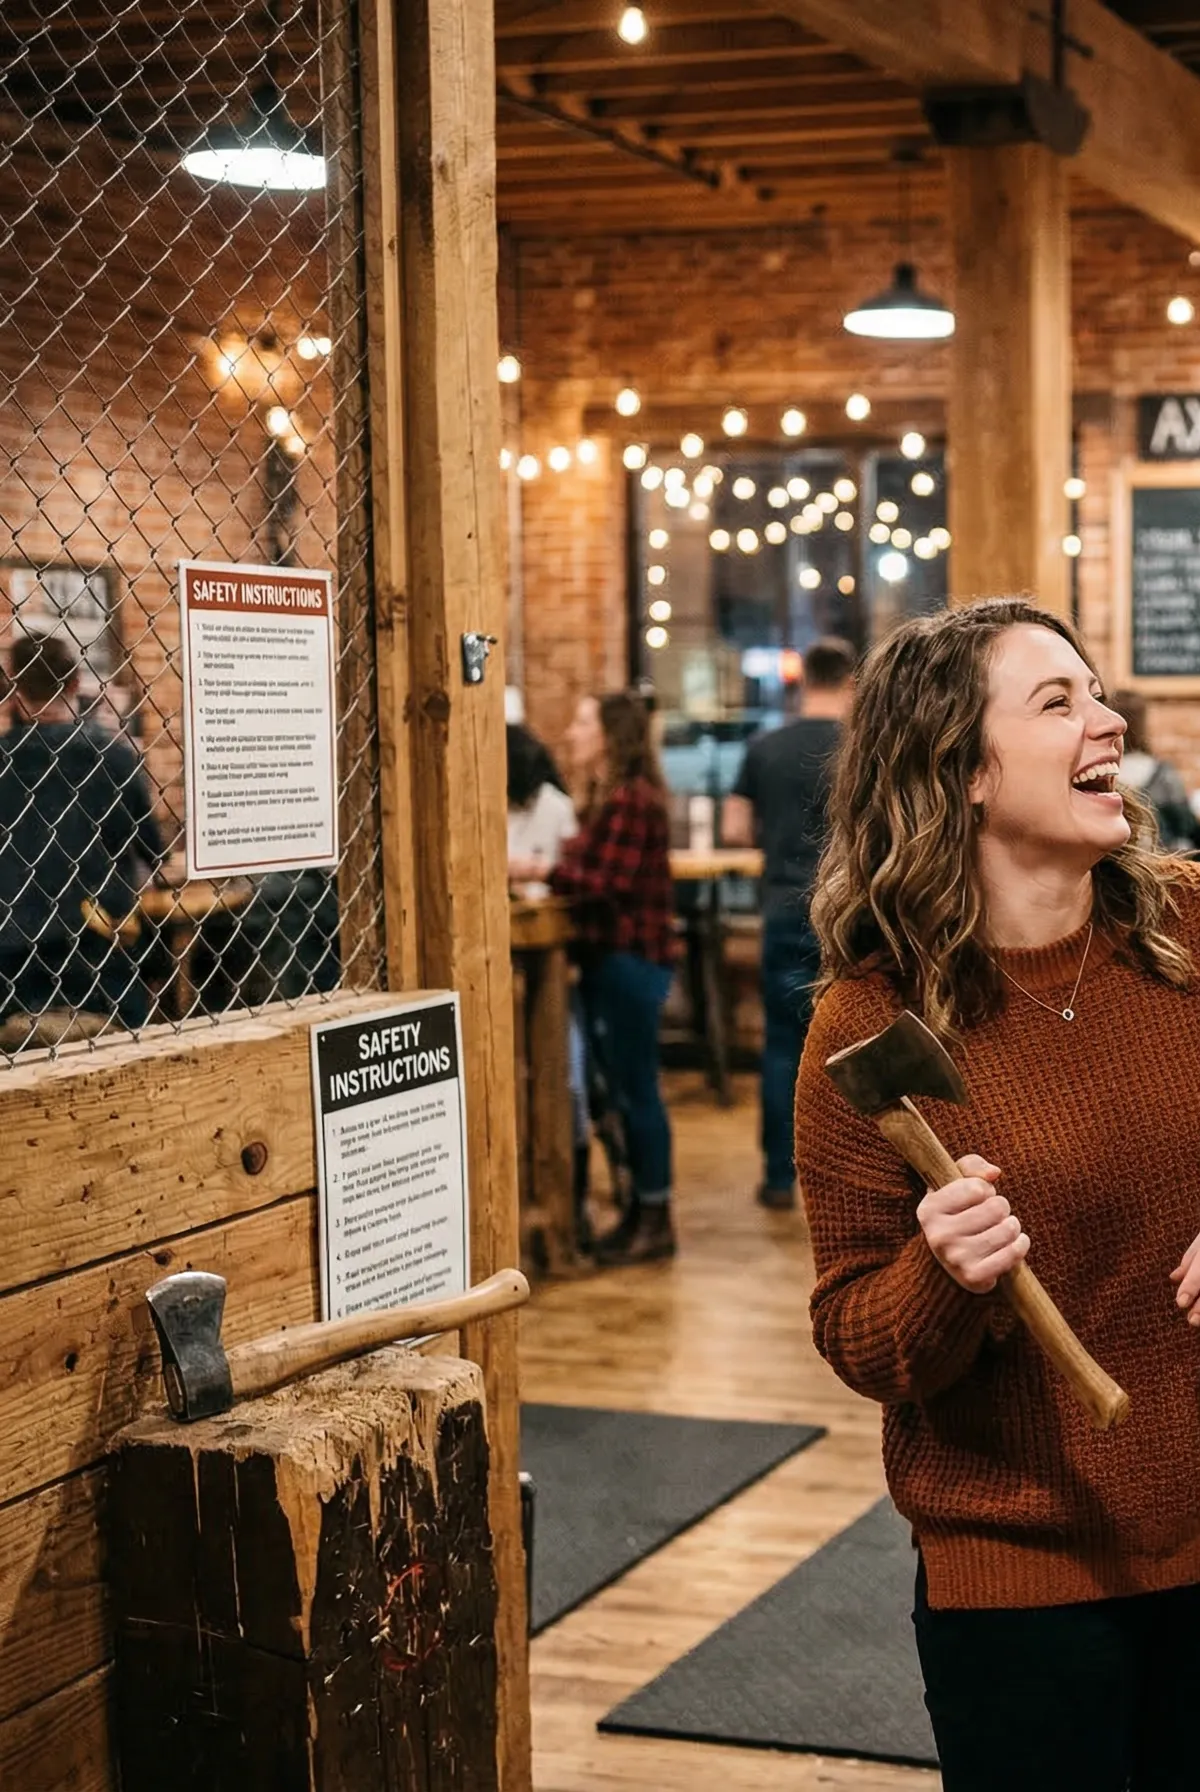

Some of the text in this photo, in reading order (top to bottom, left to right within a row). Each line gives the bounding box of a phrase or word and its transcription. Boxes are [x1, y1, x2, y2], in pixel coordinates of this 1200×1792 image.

[192, 579, 323, 609] SAFETY INSTRUCTIONS
[358, 1020, 422, 1061] SAFETY
[329, 1046, 452, 1102] INSTRUCTIONS
